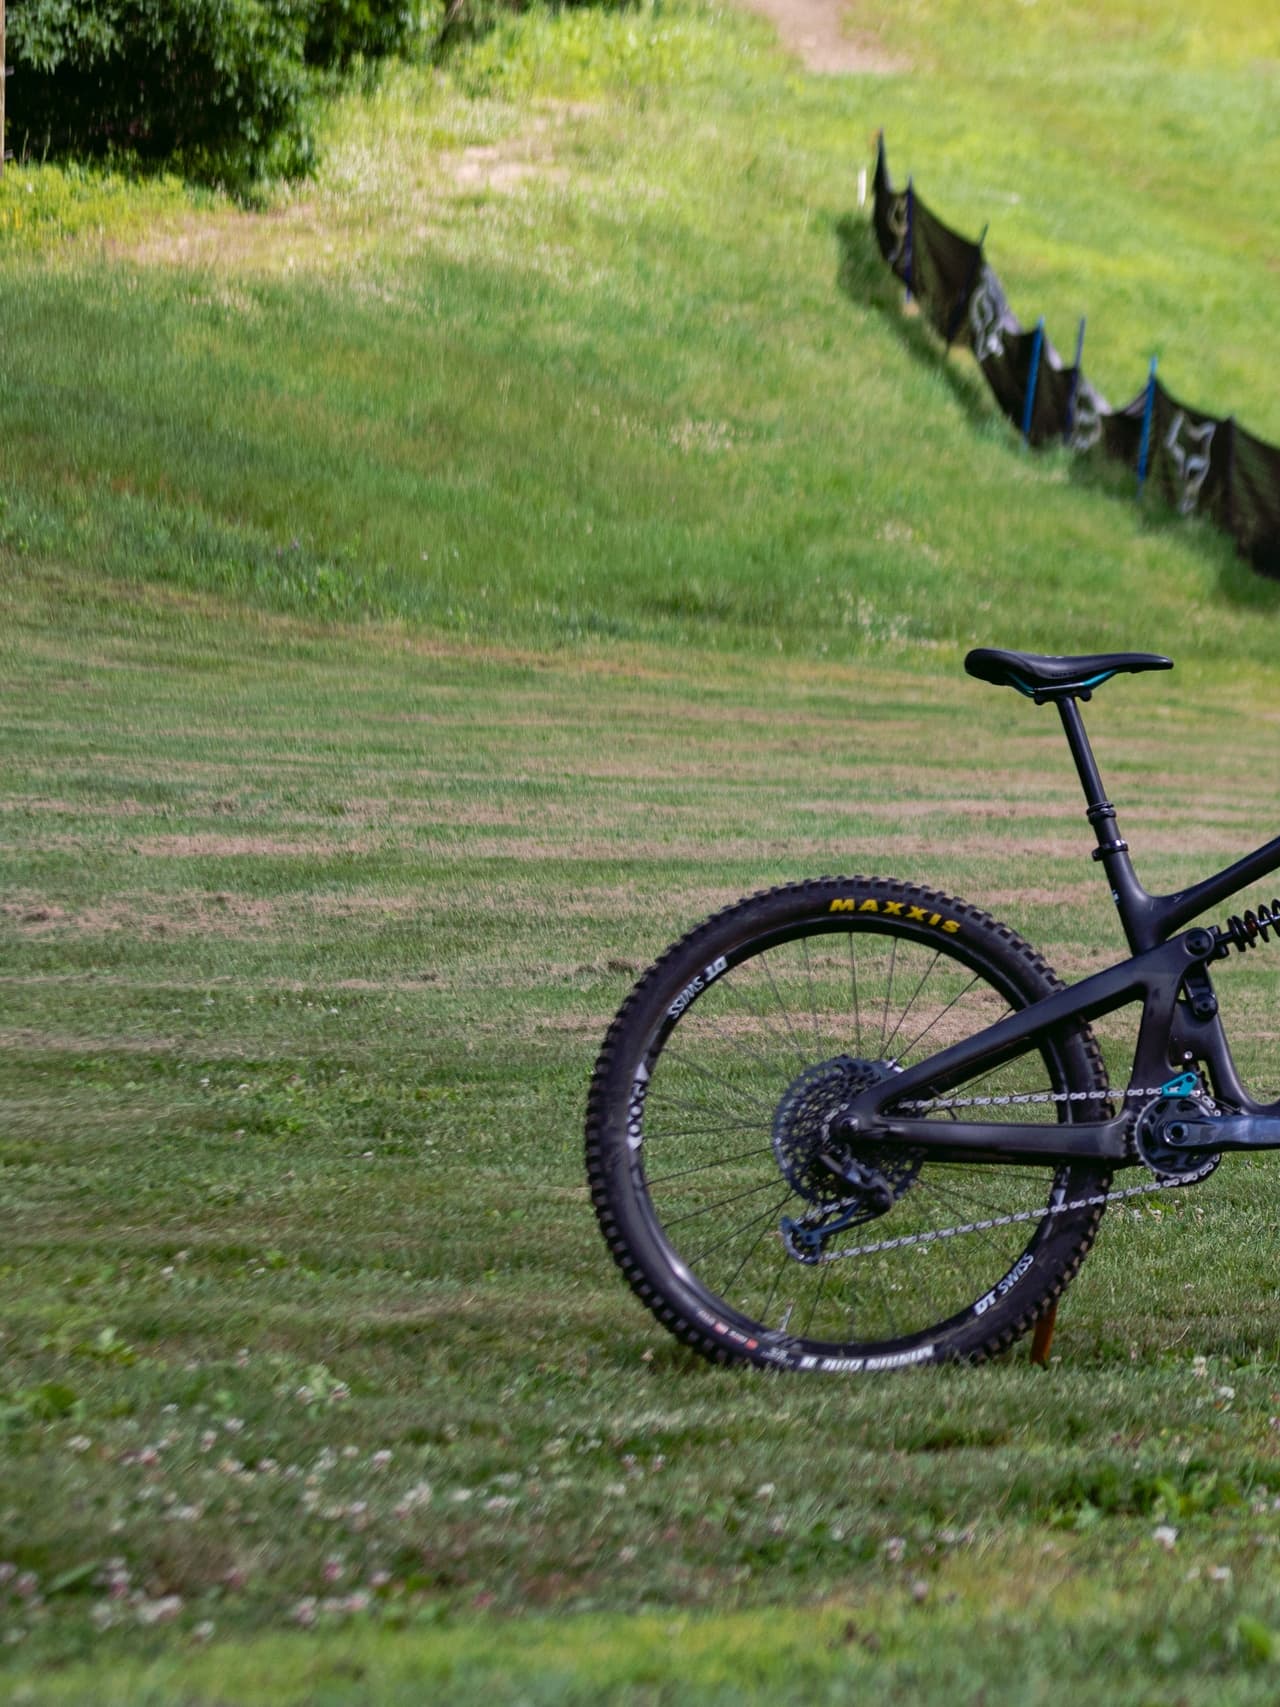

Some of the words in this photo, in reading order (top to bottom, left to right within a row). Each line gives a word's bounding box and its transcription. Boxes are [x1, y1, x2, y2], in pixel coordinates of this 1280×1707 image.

[829, 898, 961, 934] MAXXIS
[704, 955, 728, 981] DT
[666, 976, 705, 1020] SWISS
[974, 1290, 996, 1315] DT
[998, 1253, 1034, 1295] SWISS
